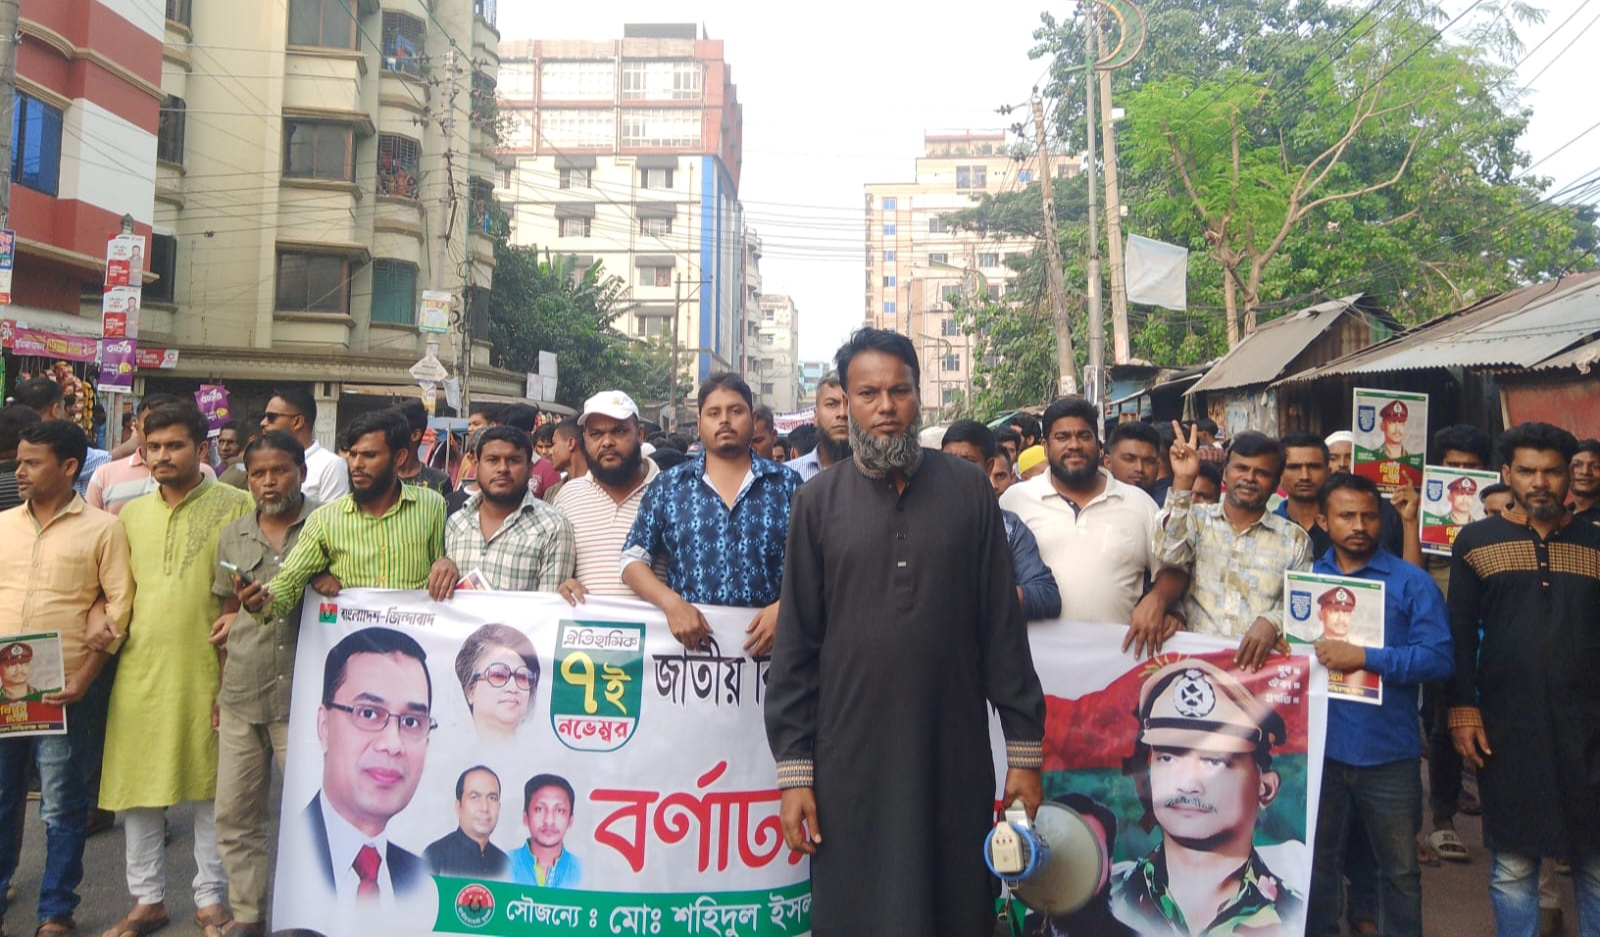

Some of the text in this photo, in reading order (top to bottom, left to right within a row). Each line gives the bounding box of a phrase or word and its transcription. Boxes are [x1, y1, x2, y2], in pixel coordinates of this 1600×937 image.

[563, 630, 639, 649] ঐতিহাসিক
[652, 636, 745, 706] জাতীয়
[557, 719, 628, 743] নভেম্বর
[506, 896, 582, 924] সৌজন্যে
[609, 906, 662, 935] মোঃ
[673, 896, 761, 937] শহিদুল
